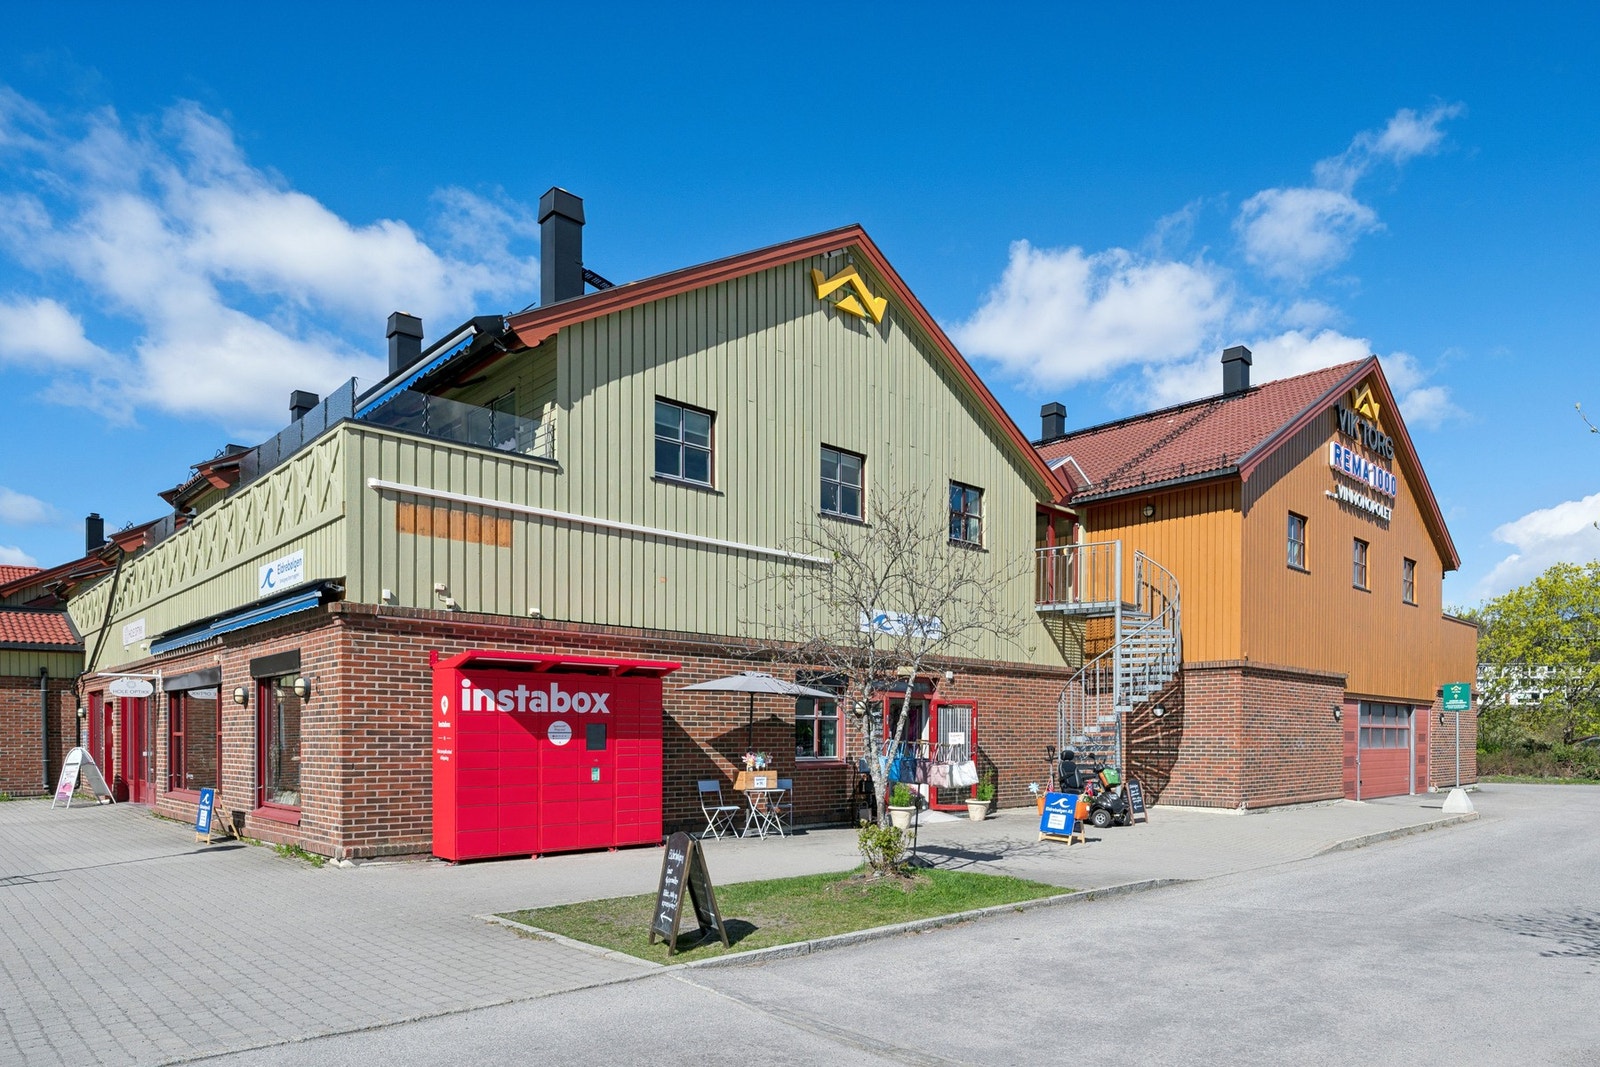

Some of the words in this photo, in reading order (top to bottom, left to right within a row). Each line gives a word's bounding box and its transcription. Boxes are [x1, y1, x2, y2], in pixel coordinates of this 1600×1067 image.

[1333, 442, 1370, 483] REMA
[1371, 464, 1396, 498] 1000
[1337, 484, 1392, 521] VINMONOPOLET
[461, 678, 610, 714] instabox
